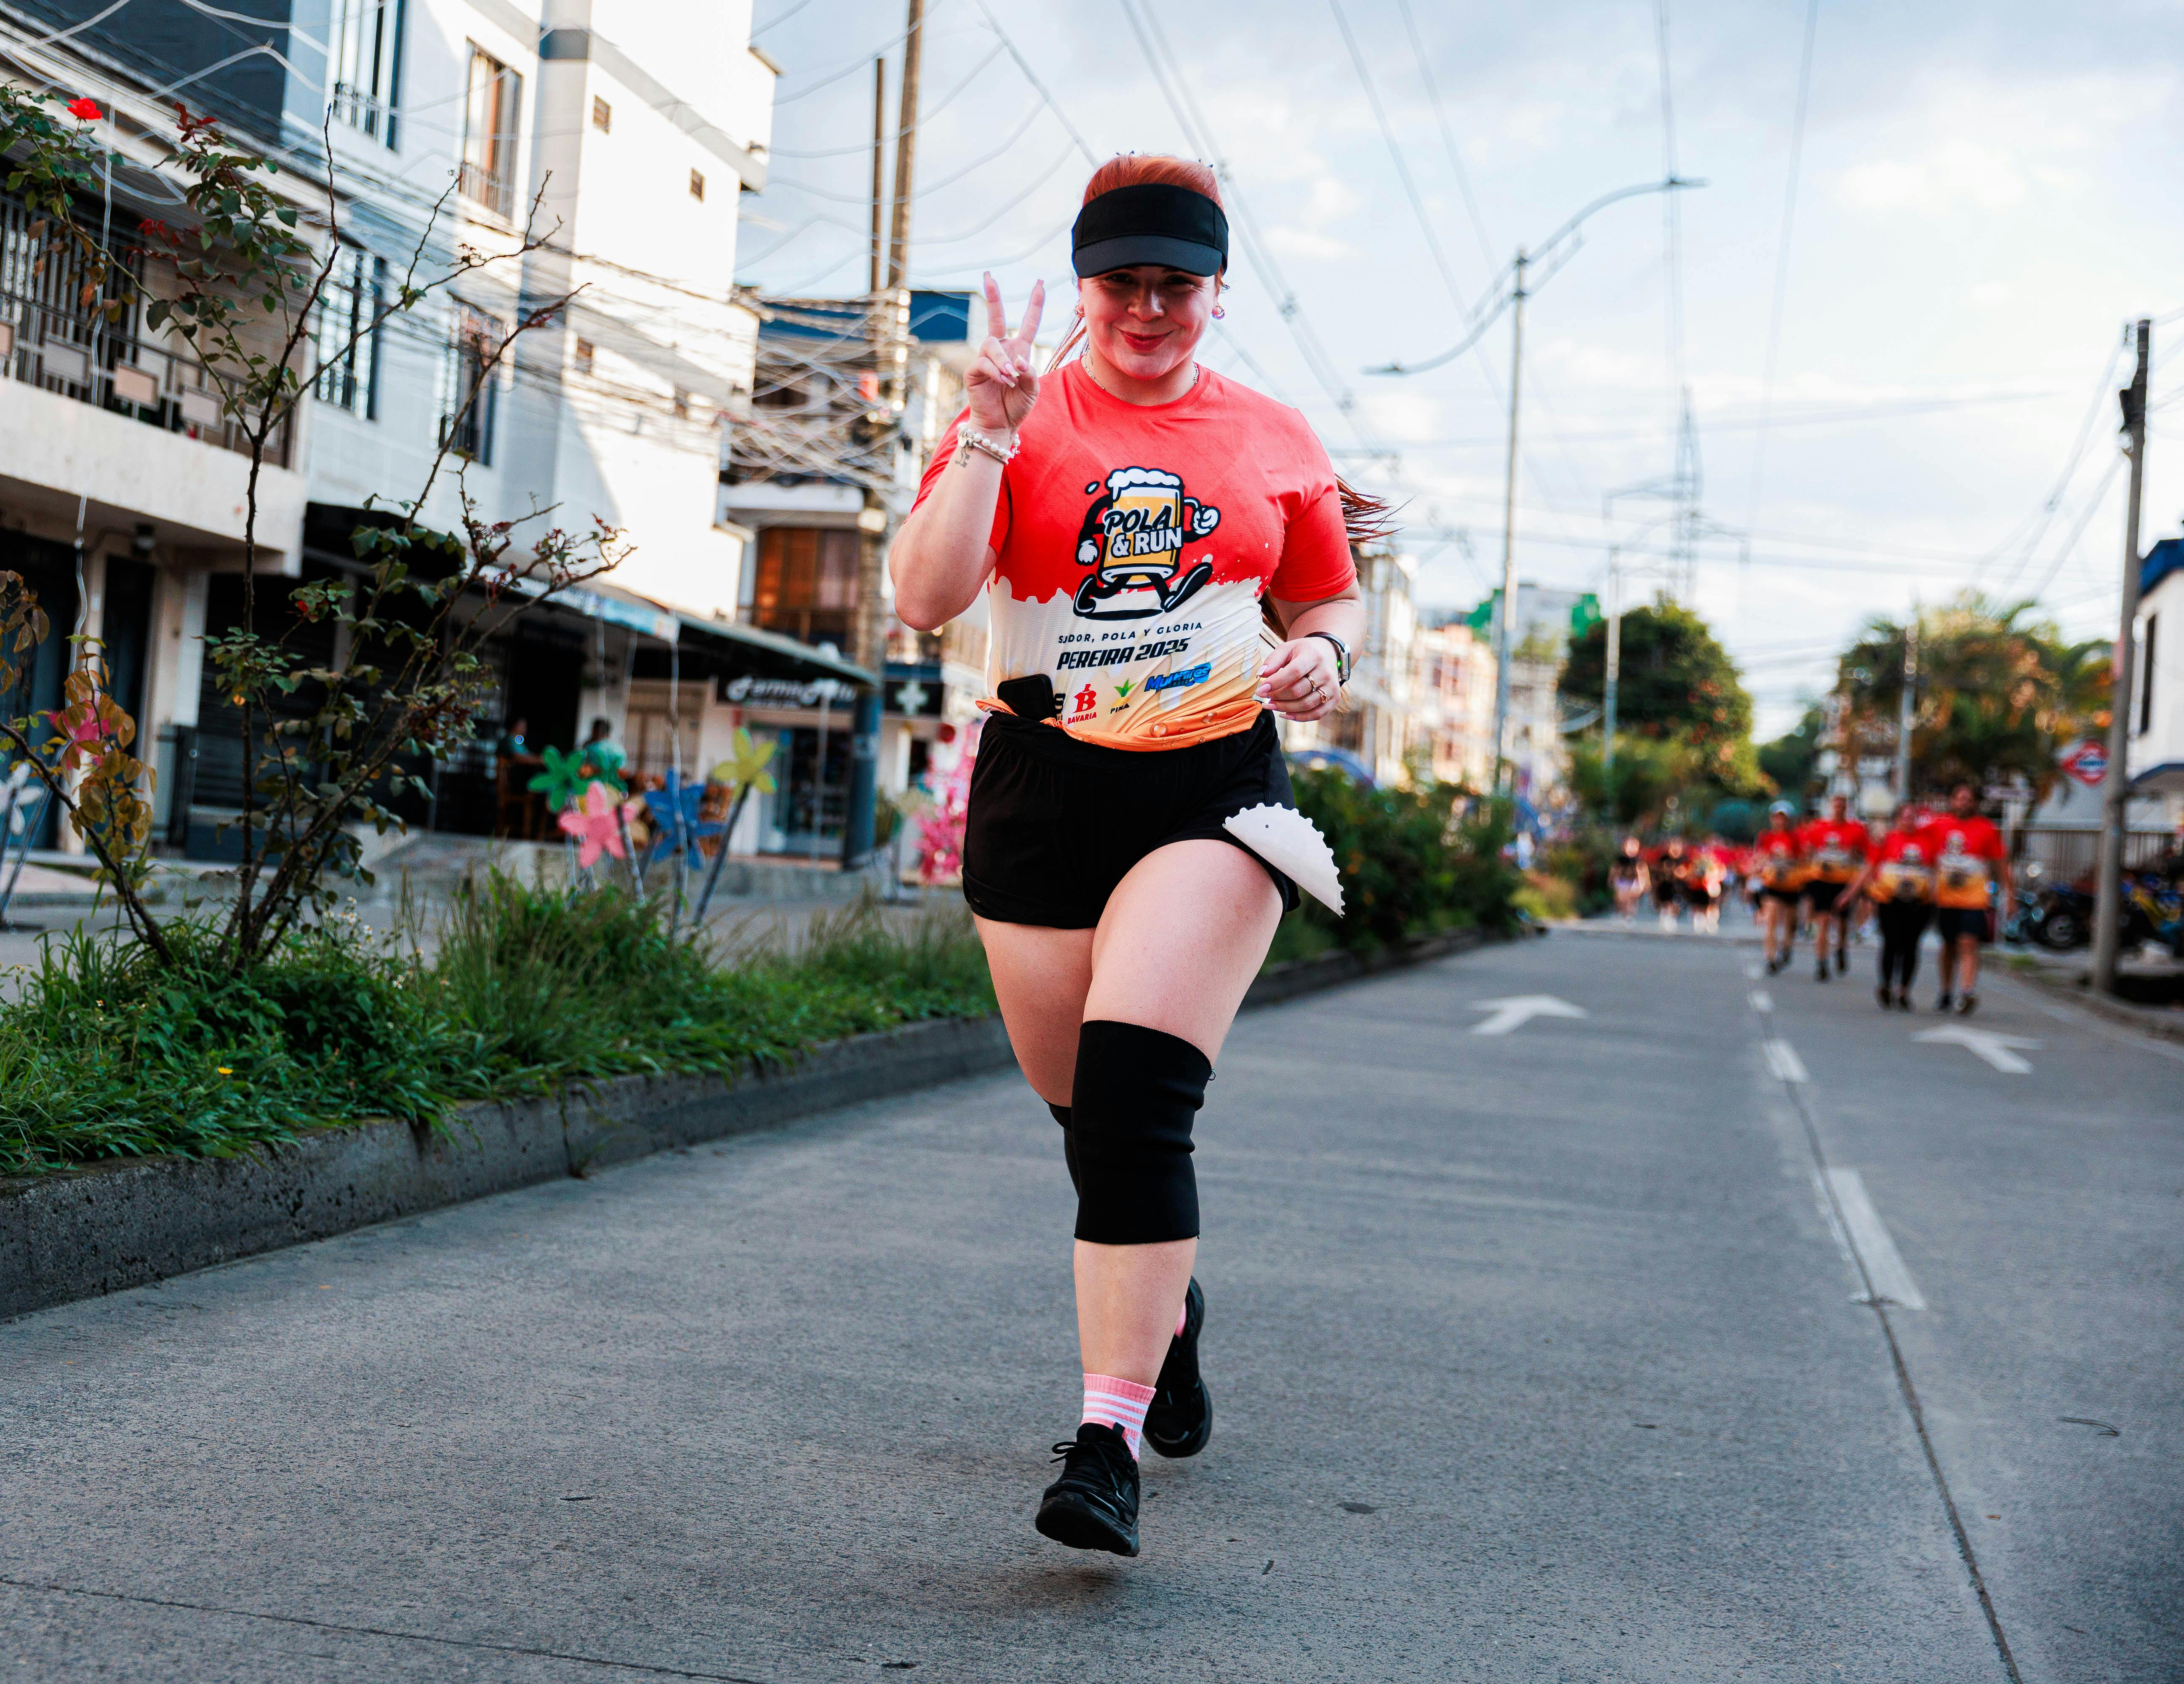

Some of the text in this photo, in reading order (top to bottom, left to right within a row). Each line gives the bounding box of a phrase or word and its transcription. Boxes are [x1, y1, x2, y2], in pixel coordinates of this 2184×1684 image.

[1104, 504, 1173, 536] POLA
[1112, 526, 1182, 557] & RUN
[1101, 631, 1136, 641] POLA
[1157, 622, 1203, 634] GLORIA
[1056, 637, 1191, 670] PEREIRA 2025
[1067, 711, 1097, 725] BAVARIA
